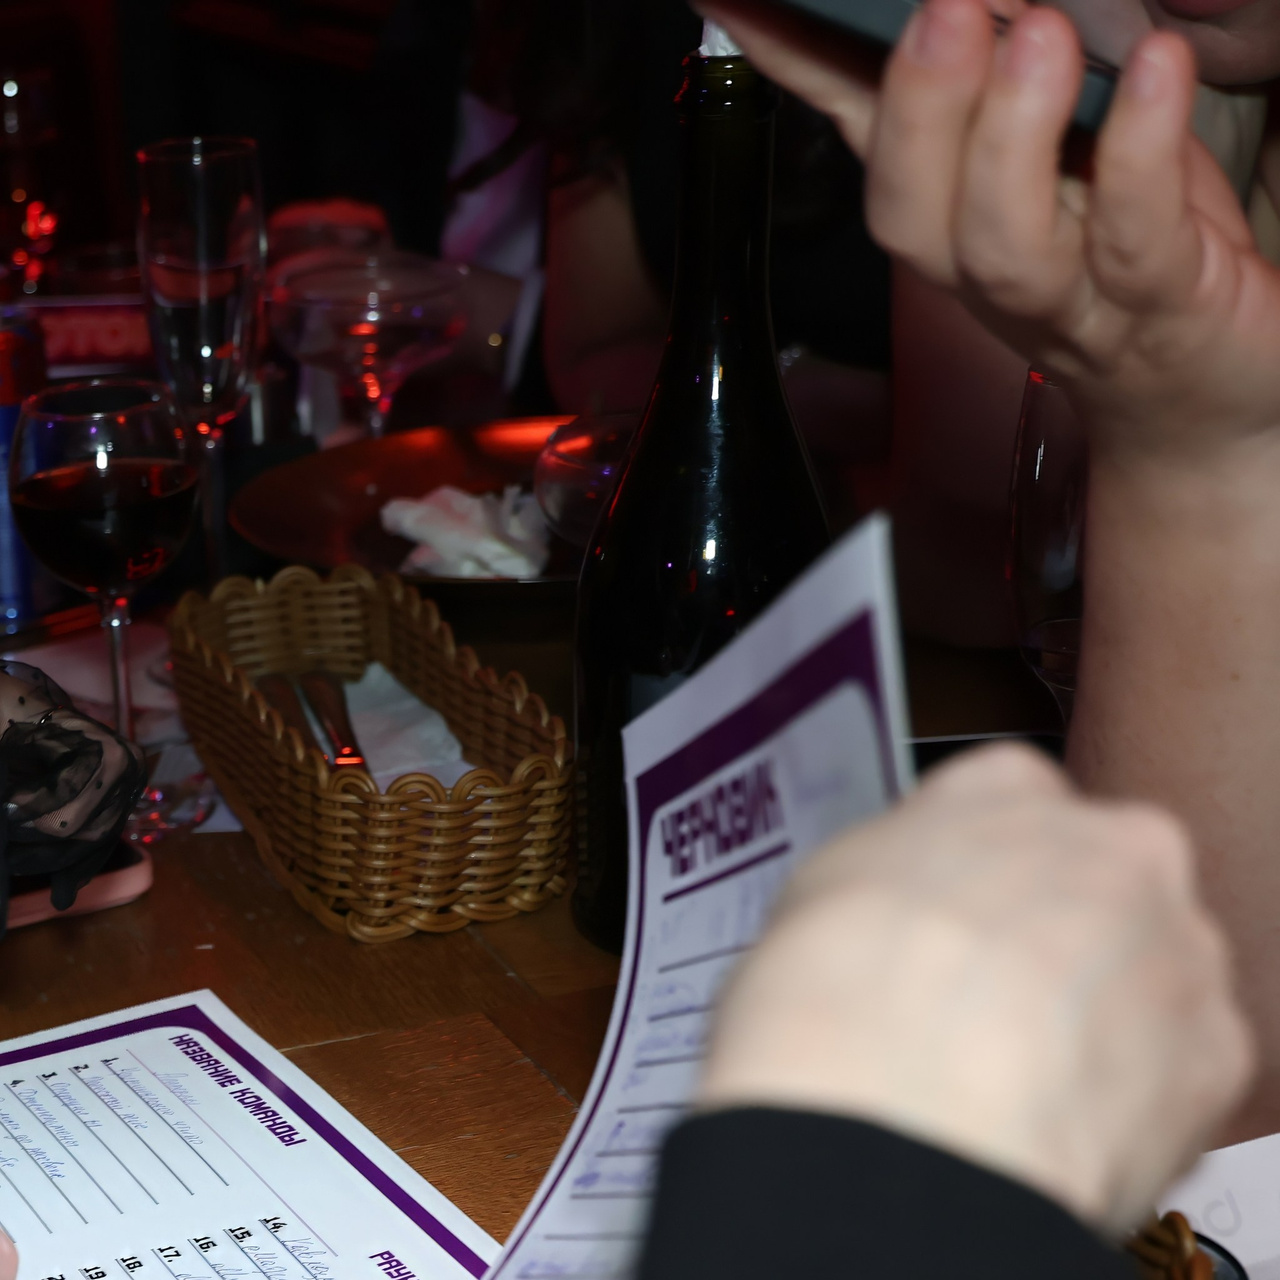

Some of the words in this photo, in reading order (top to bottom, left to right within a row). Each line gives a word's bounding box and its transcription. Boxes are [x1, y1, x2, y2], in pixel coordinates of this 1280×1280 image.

[167, 1033, 244, 1089] НАЗВАНИЕ
[228, 1087, 308, 1147] КОМАНДЫ
[259, 1216, 288, 1234] 14.
[227, 1226, 254, 1243] 15.
[192, 1236, 218, 1253] 16.
[156, 1245, 182, 1263] 17.
[119, 1256, 144, 1273] 18.
